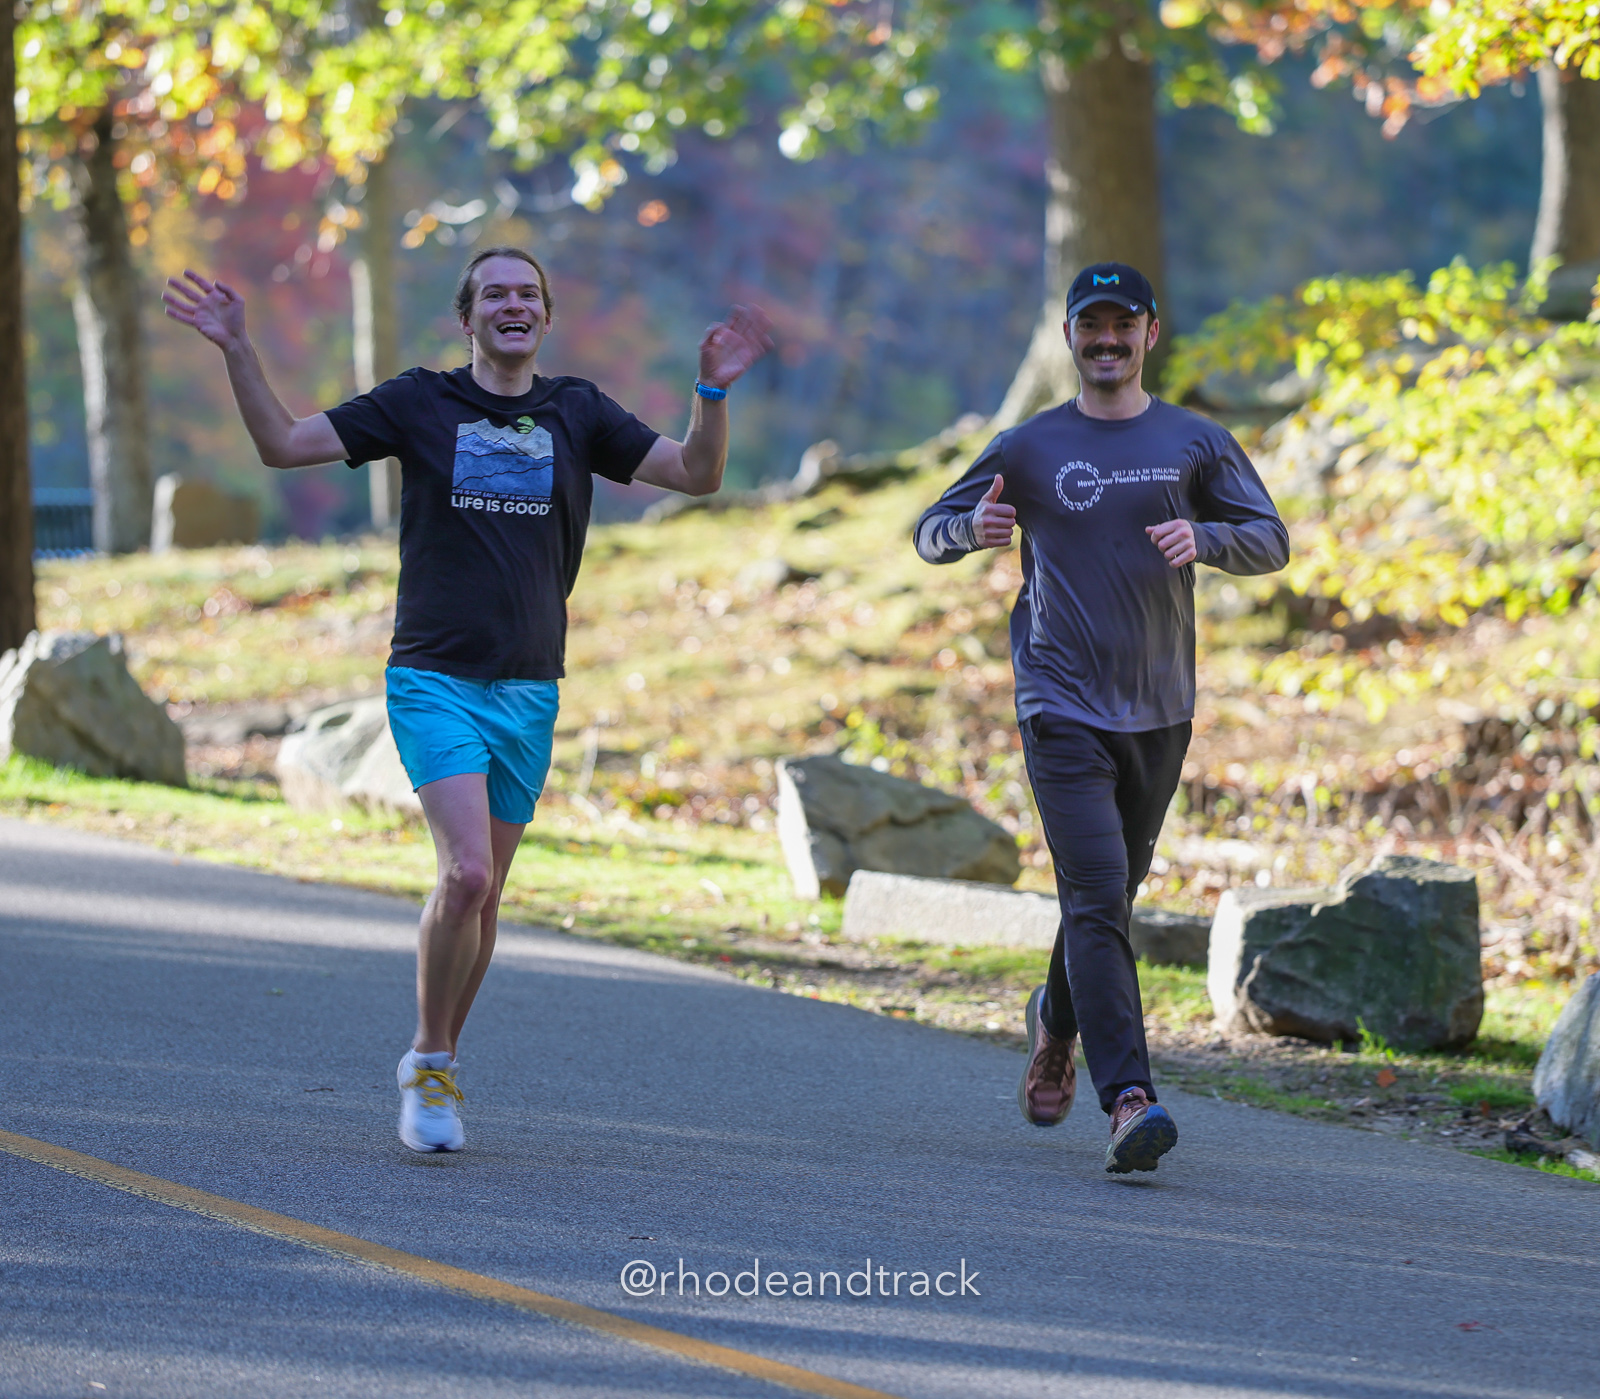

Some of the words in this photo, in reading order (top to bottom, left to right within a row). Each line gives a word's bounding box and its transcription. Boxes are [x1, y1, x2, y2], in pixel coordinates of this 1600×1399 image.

[1151, 467, 1180, 475] WALK/RUN
[1077, 480, 1095, 488] Move
[1097, 478, 1113, 486] Your
[1153, 474, 1179, 482] Diabetes
[486, 499, 501, 512] IS
[503, 501, 549, 516] GOOD
